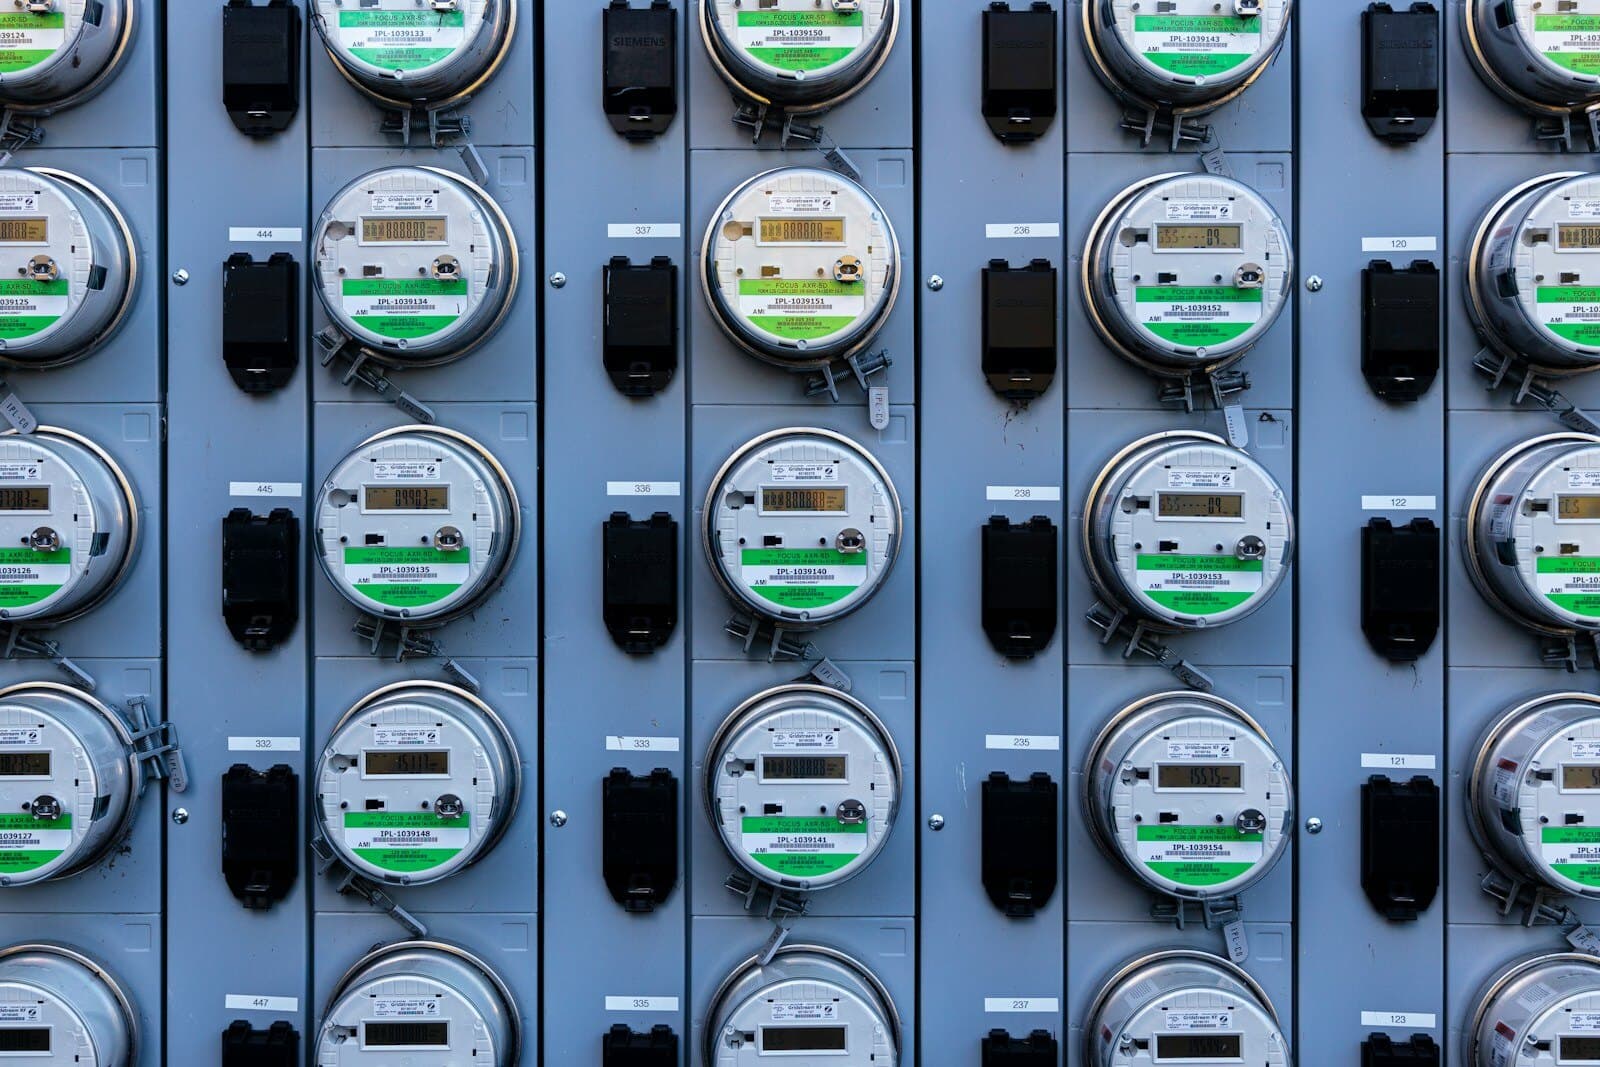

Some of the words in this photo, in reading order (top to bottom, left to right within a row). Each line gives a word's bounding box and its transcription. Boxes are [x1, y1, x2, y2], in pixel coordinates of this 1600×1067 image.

[613, 37, 666, 47] SIEMENS
[1146, 45, 1160, 53] AMI
[775, 297, 825, 305] IPL-1039151
[1015, 489, 1030, 497] 238
[1392, 498, 1406, 506] 122
[256, 740, 272, 748] 332
[634, 740, 650, 748] 333
[1014, 738, 1029, 746] 235
[1391, 757, 1404, 765] 121
[754, 847, 768, 855] AMI
